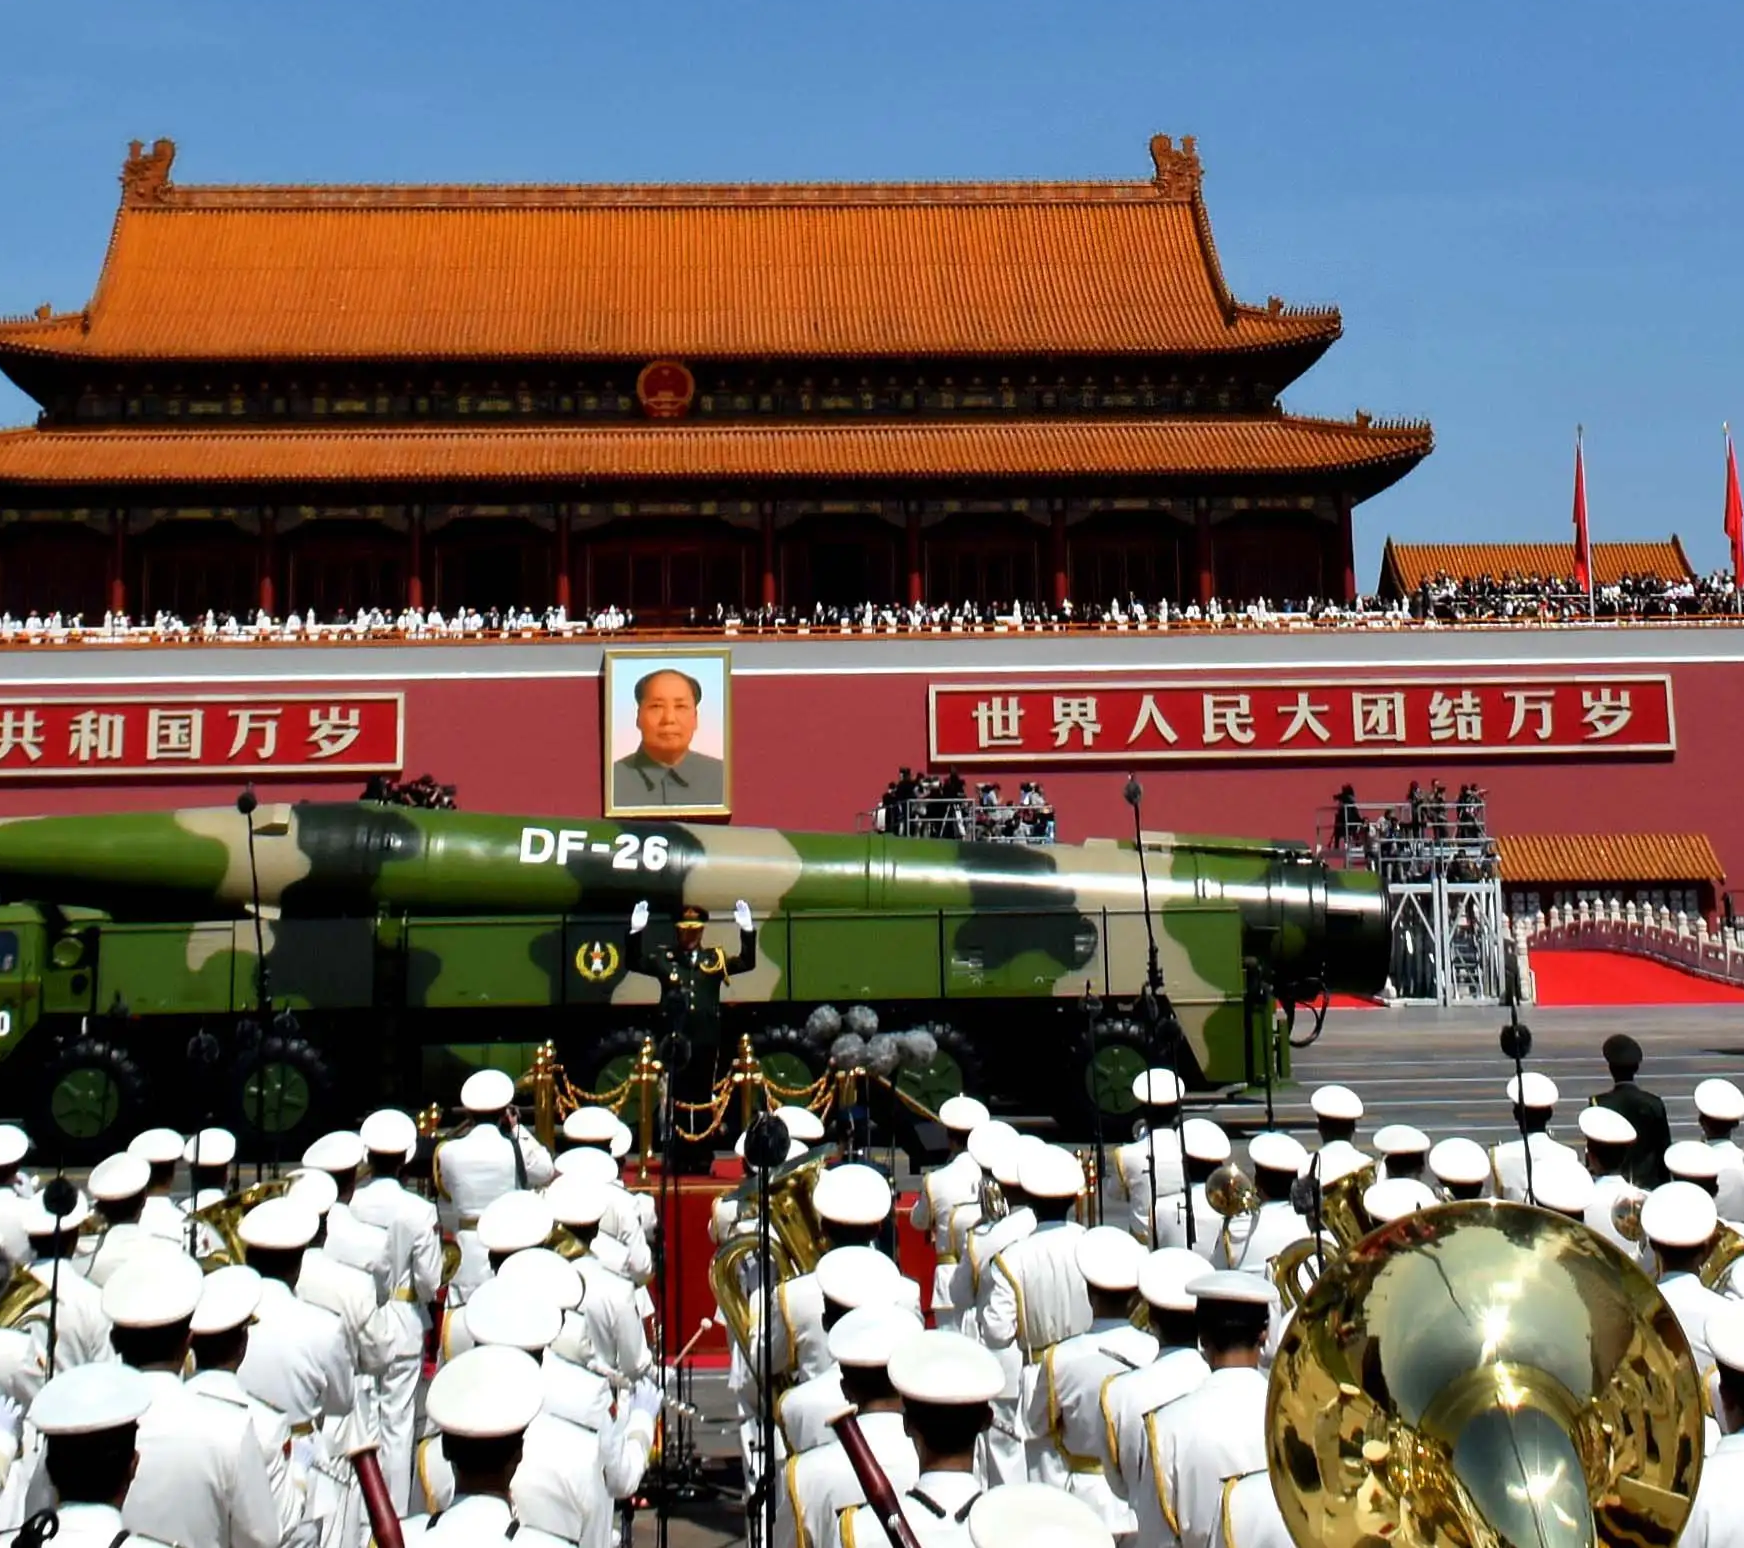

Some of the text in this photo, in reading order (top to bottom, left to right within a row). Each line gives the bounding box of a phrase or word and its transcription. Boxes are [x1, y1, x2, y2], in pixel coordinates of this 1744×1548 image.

[970, 687, 1634, 748] 世界人民大团结万岁
[519, 826, 669, 871] DF-26
